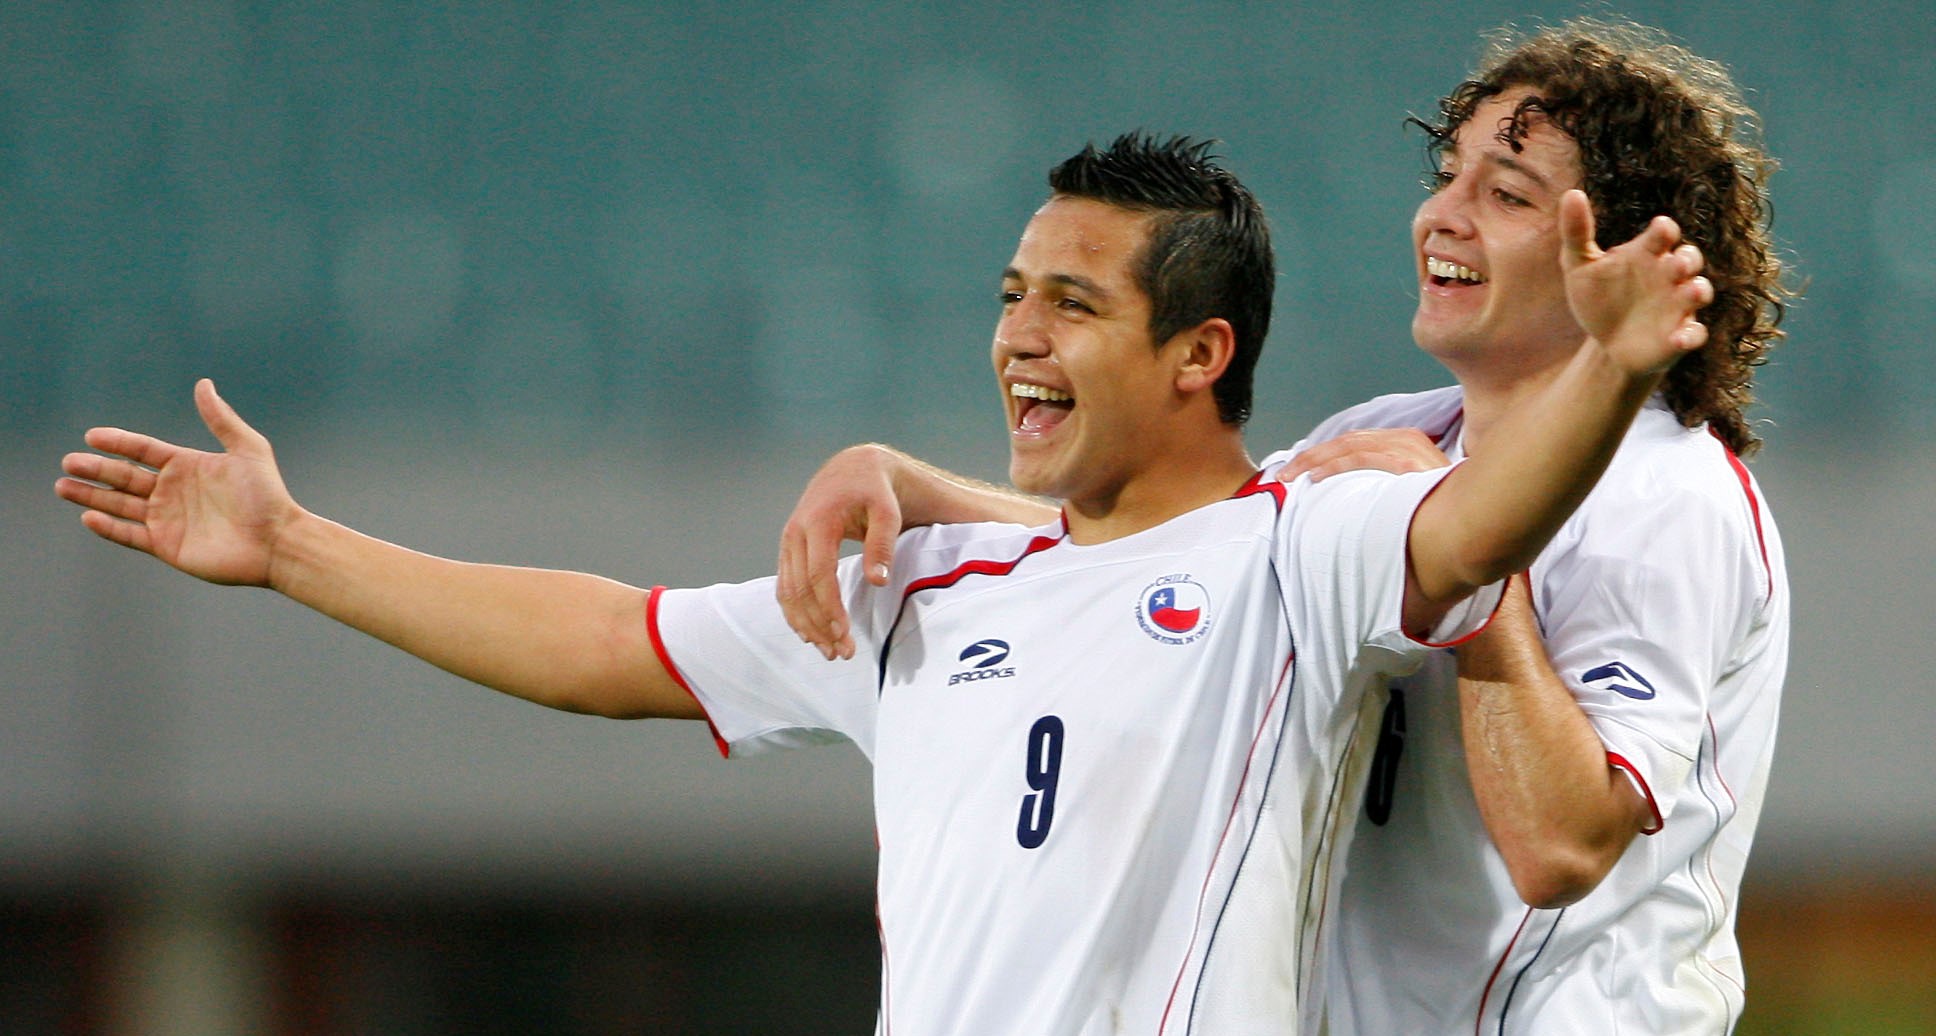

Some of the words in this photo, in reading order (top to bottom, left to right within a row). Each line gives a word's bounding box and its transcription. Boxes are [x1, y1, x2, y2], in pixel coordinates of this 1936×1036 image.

[1155, 573, 1192, 587] CHILE
[948, 667, 1016, 686] BROOKS
[1017, 715, 1064, 849] 9
[1365, 688, 1407, 827] 6
